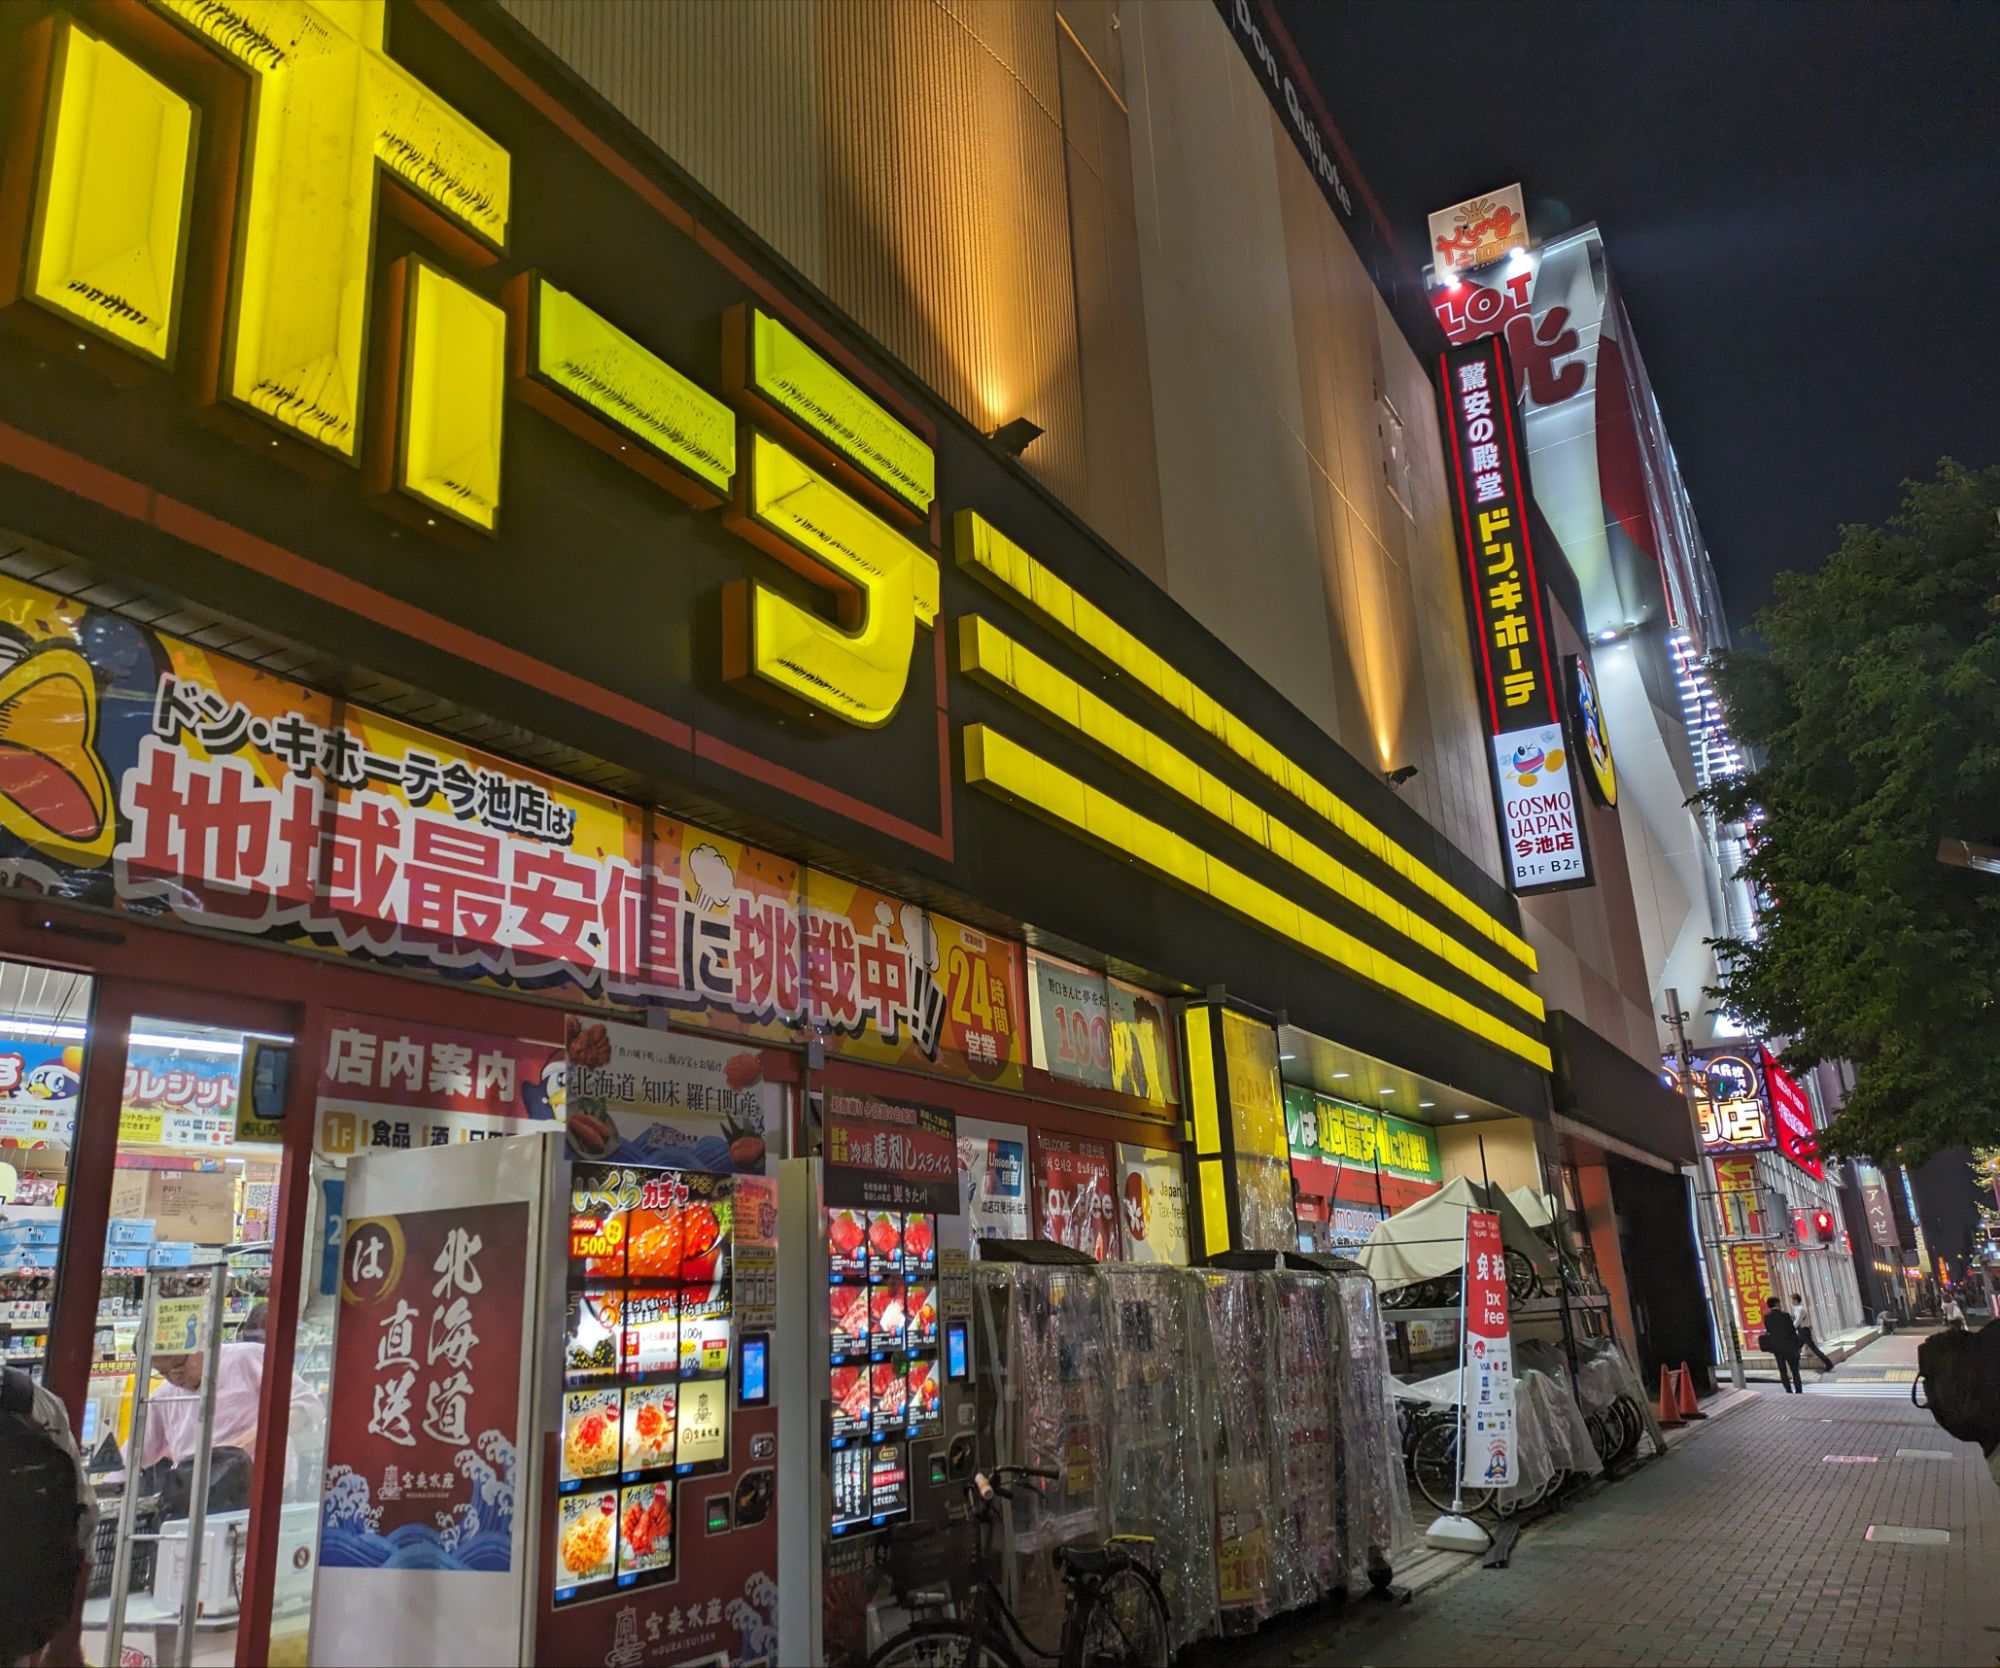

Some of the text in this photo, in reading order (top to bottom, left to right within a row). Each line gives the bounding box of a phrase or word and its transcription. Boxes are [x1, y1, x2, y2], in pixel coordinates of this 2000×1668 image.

[1283, 76, 1352, 216] Quijote
[1458, 361, 1505, 504] 驚安の殿堂
[1478, 507, 1536, 708] ドン・キホーテ
[157, 676, 572, 843] ドン・キホーテ今池店は
[1507, 791, 1572, 819] COSMO
[1510, 811, 1573, 839] JAPAN
[1514, 832, 1575, 858] 今池店
[1517, 859, 1580, 878] B1F B2F
[124, 742, 946, 1056] 地域最安値に挑戦中!!
[323, 1027, 517, 1103] 店内案内
[965, 1029, 998, 1066] 営業
[571, 1066, 758, 1119] 北海道 知床 羅臼町産
[173, 1118, 191, 1128] VISA
[327, 1117, 353, 1148] 1F
[371, 1120, 411, 1149] 食品
[431, 1125, 450, 1149] 酒
[988, 1151, 1022, 1175] UnionPay
[1038, 1137, 1072, 1153] WELCOME
[1054, 1158, 1072, 1172] 오세요
[572, 1170, 689, 1213] いくらガチャ
[1038, 1178, 1071, 1217] Tax
[1866, 1188, 1888, 1235] アペゼ
[352, 1236, 385, 1283] は
[1733, 1246, 1763, 1326] 左折です
[421, 1227, 483, 1447] 北海道
[366, 1298, 420, 1447] 直送
